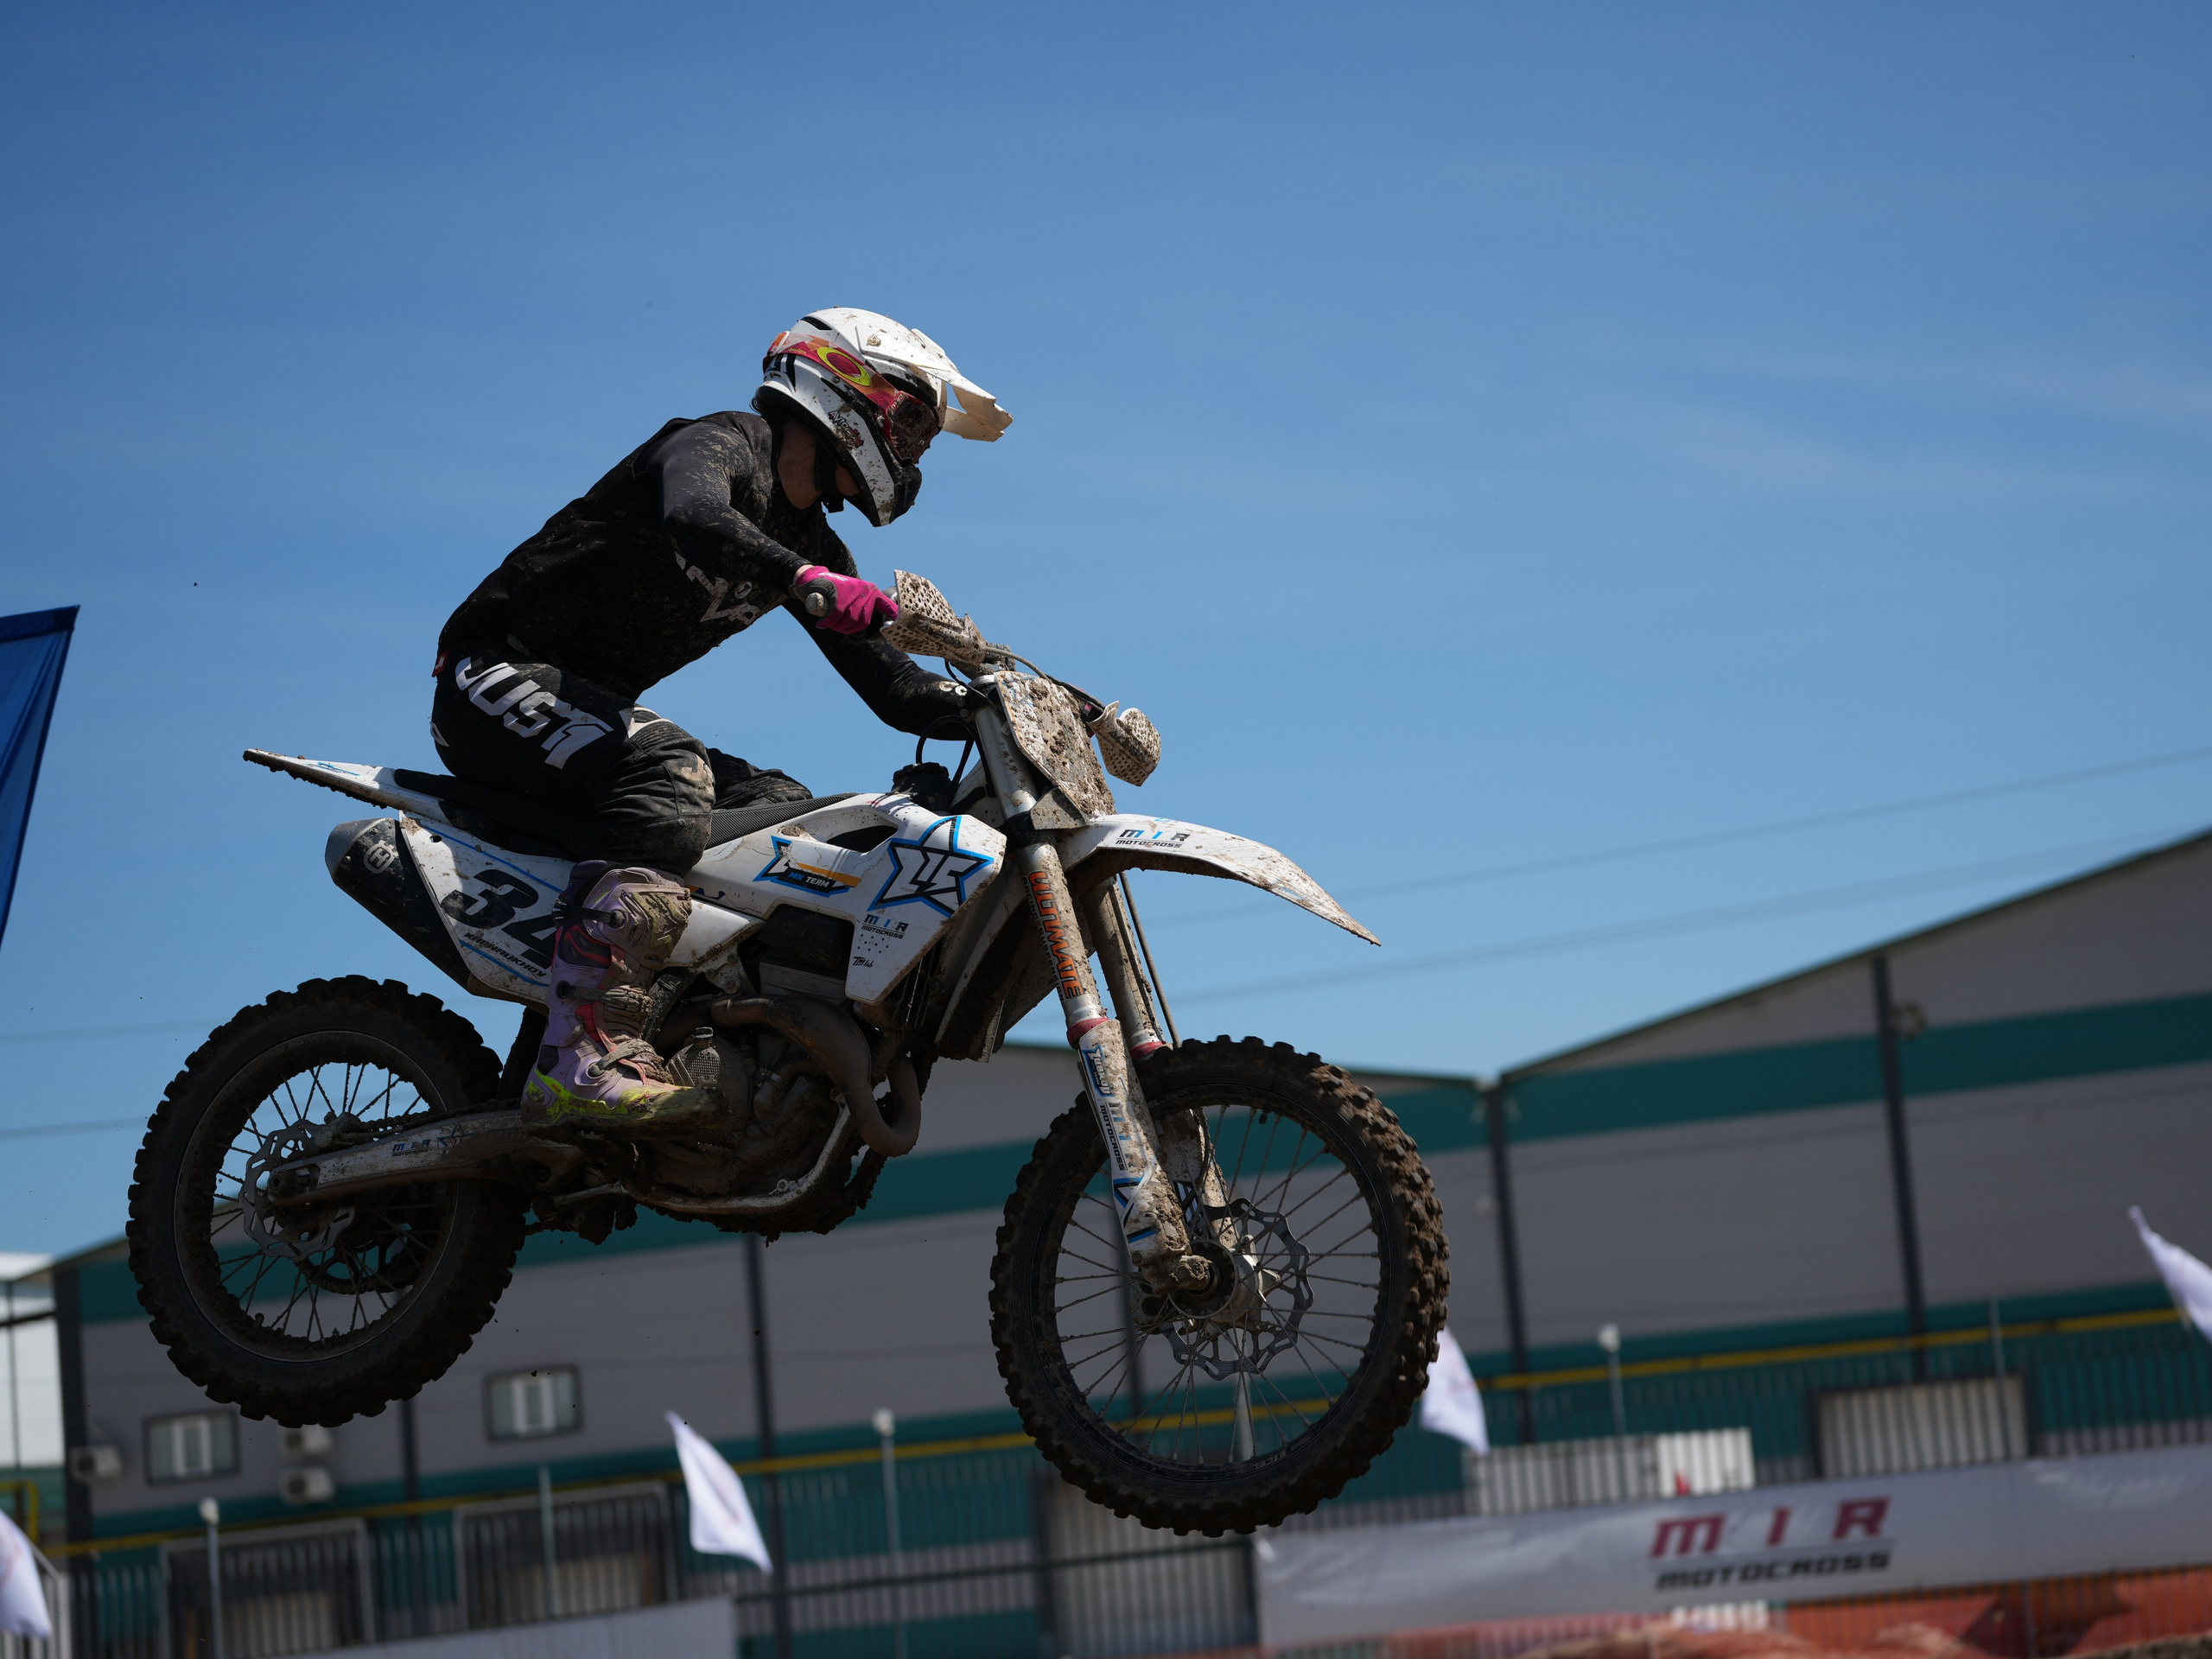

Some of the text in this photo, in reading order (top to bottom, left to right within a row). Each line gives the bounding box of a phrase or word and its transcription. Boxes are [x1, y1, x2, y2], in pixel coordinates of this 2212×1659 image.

[1116, 839, 1182, 848] MOTOCROSS
[787, 872, 830, 888] MX TEAM
[861, 925, 905, 939] MOTOCROSS
[1028, 870, 1084, 999] ULTIMATE
[1099, 1104, 1125, 1172] MOTOCROSS
[391, 1148, 429, 1158] MOTOCROSS
[1251, 1450, 1287, 1470] EXCEL
[1655, 1549, 1892, 1592] MOTOCROSS
